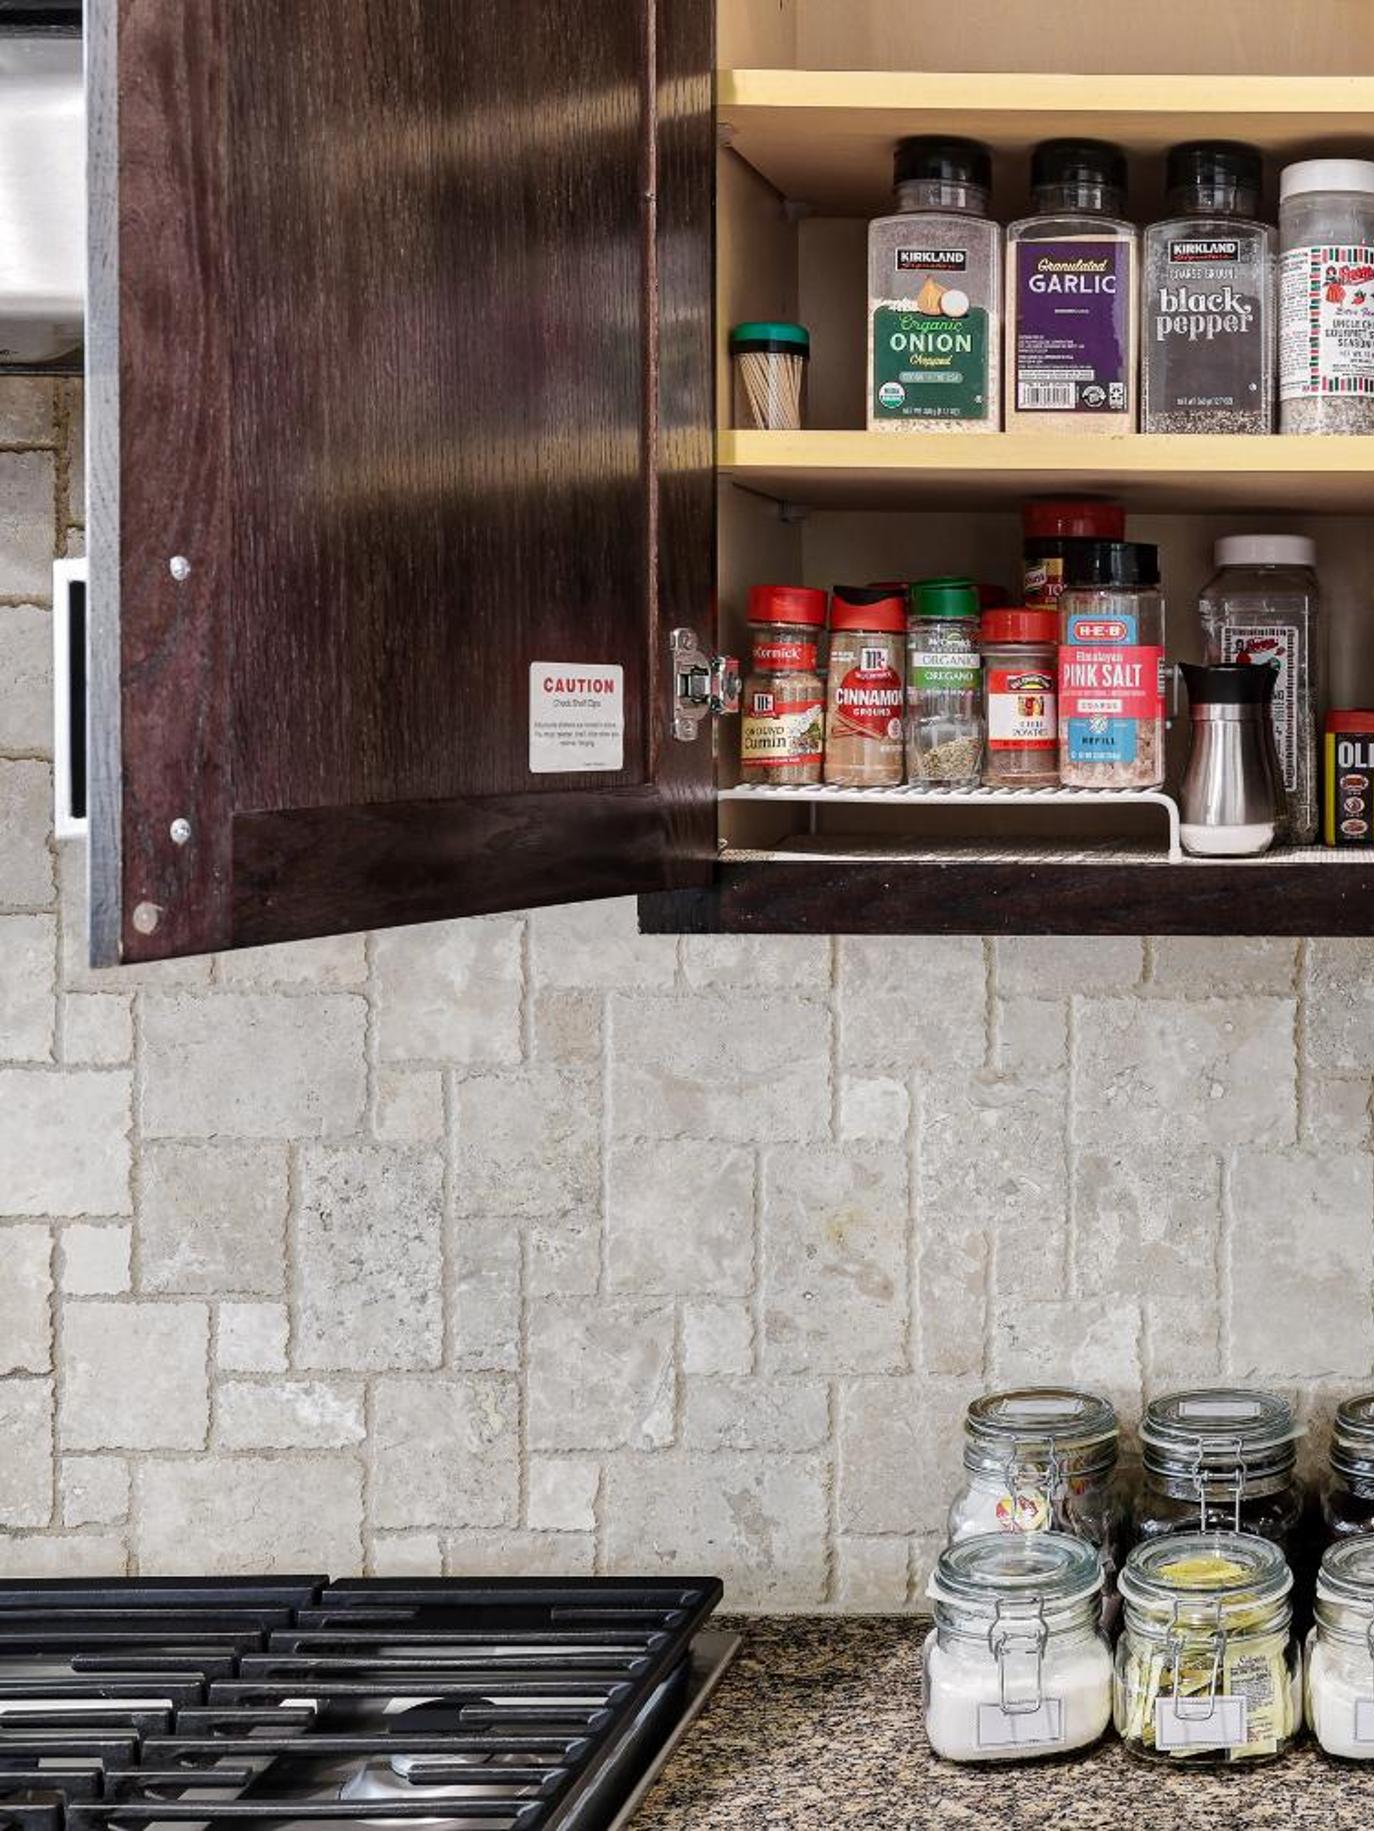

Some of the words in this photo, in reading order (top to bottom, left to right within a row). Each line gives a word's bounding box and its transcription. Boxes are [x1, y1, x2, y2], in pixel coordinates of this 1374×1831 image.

[900, 251, 965, 262] KIRKLAND
[1173, 243, 1236, 255] KIRKLAND
[1037, 258, 1109, 272] Granulated
[1028, 274, 1117, 294] GARLIC
[1158, 286, 1253, 315] black
[899, 314, 963, 333] Organic
[1155, 313, 1254, 342] pepper
[889, 332, 972, 353] ONION
[543, 677, 615, 694] CAUTION
[1063, 664, 1098, 687] PINK
[1102, 664, 1143, 688] SALT
[744, 737, 787, 750] Cumin
